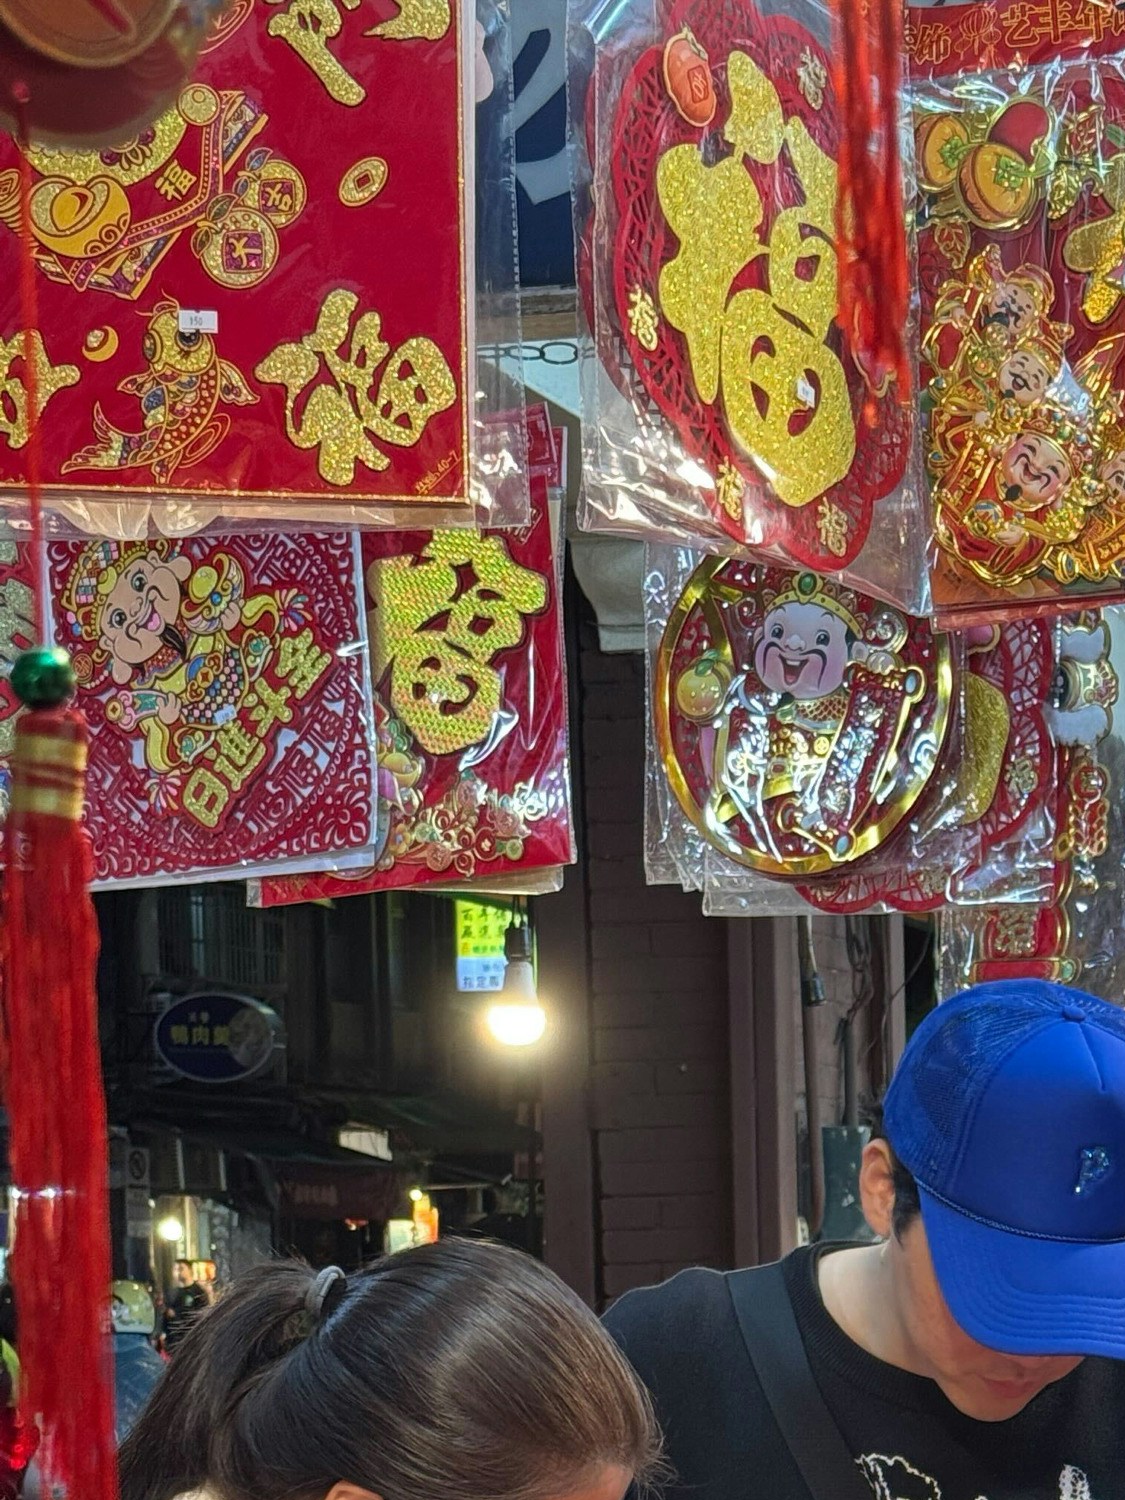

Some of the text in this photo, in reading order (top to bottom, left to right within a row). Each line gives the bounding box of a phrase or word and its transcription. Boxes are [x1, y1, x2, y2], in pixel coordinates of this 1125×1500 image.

[155, 159, 197, 200] 福
[655, 50, 856, 508] 福
[253, 288, 457, 486] 福
[182, 628, 333, 829] 日進斗金
